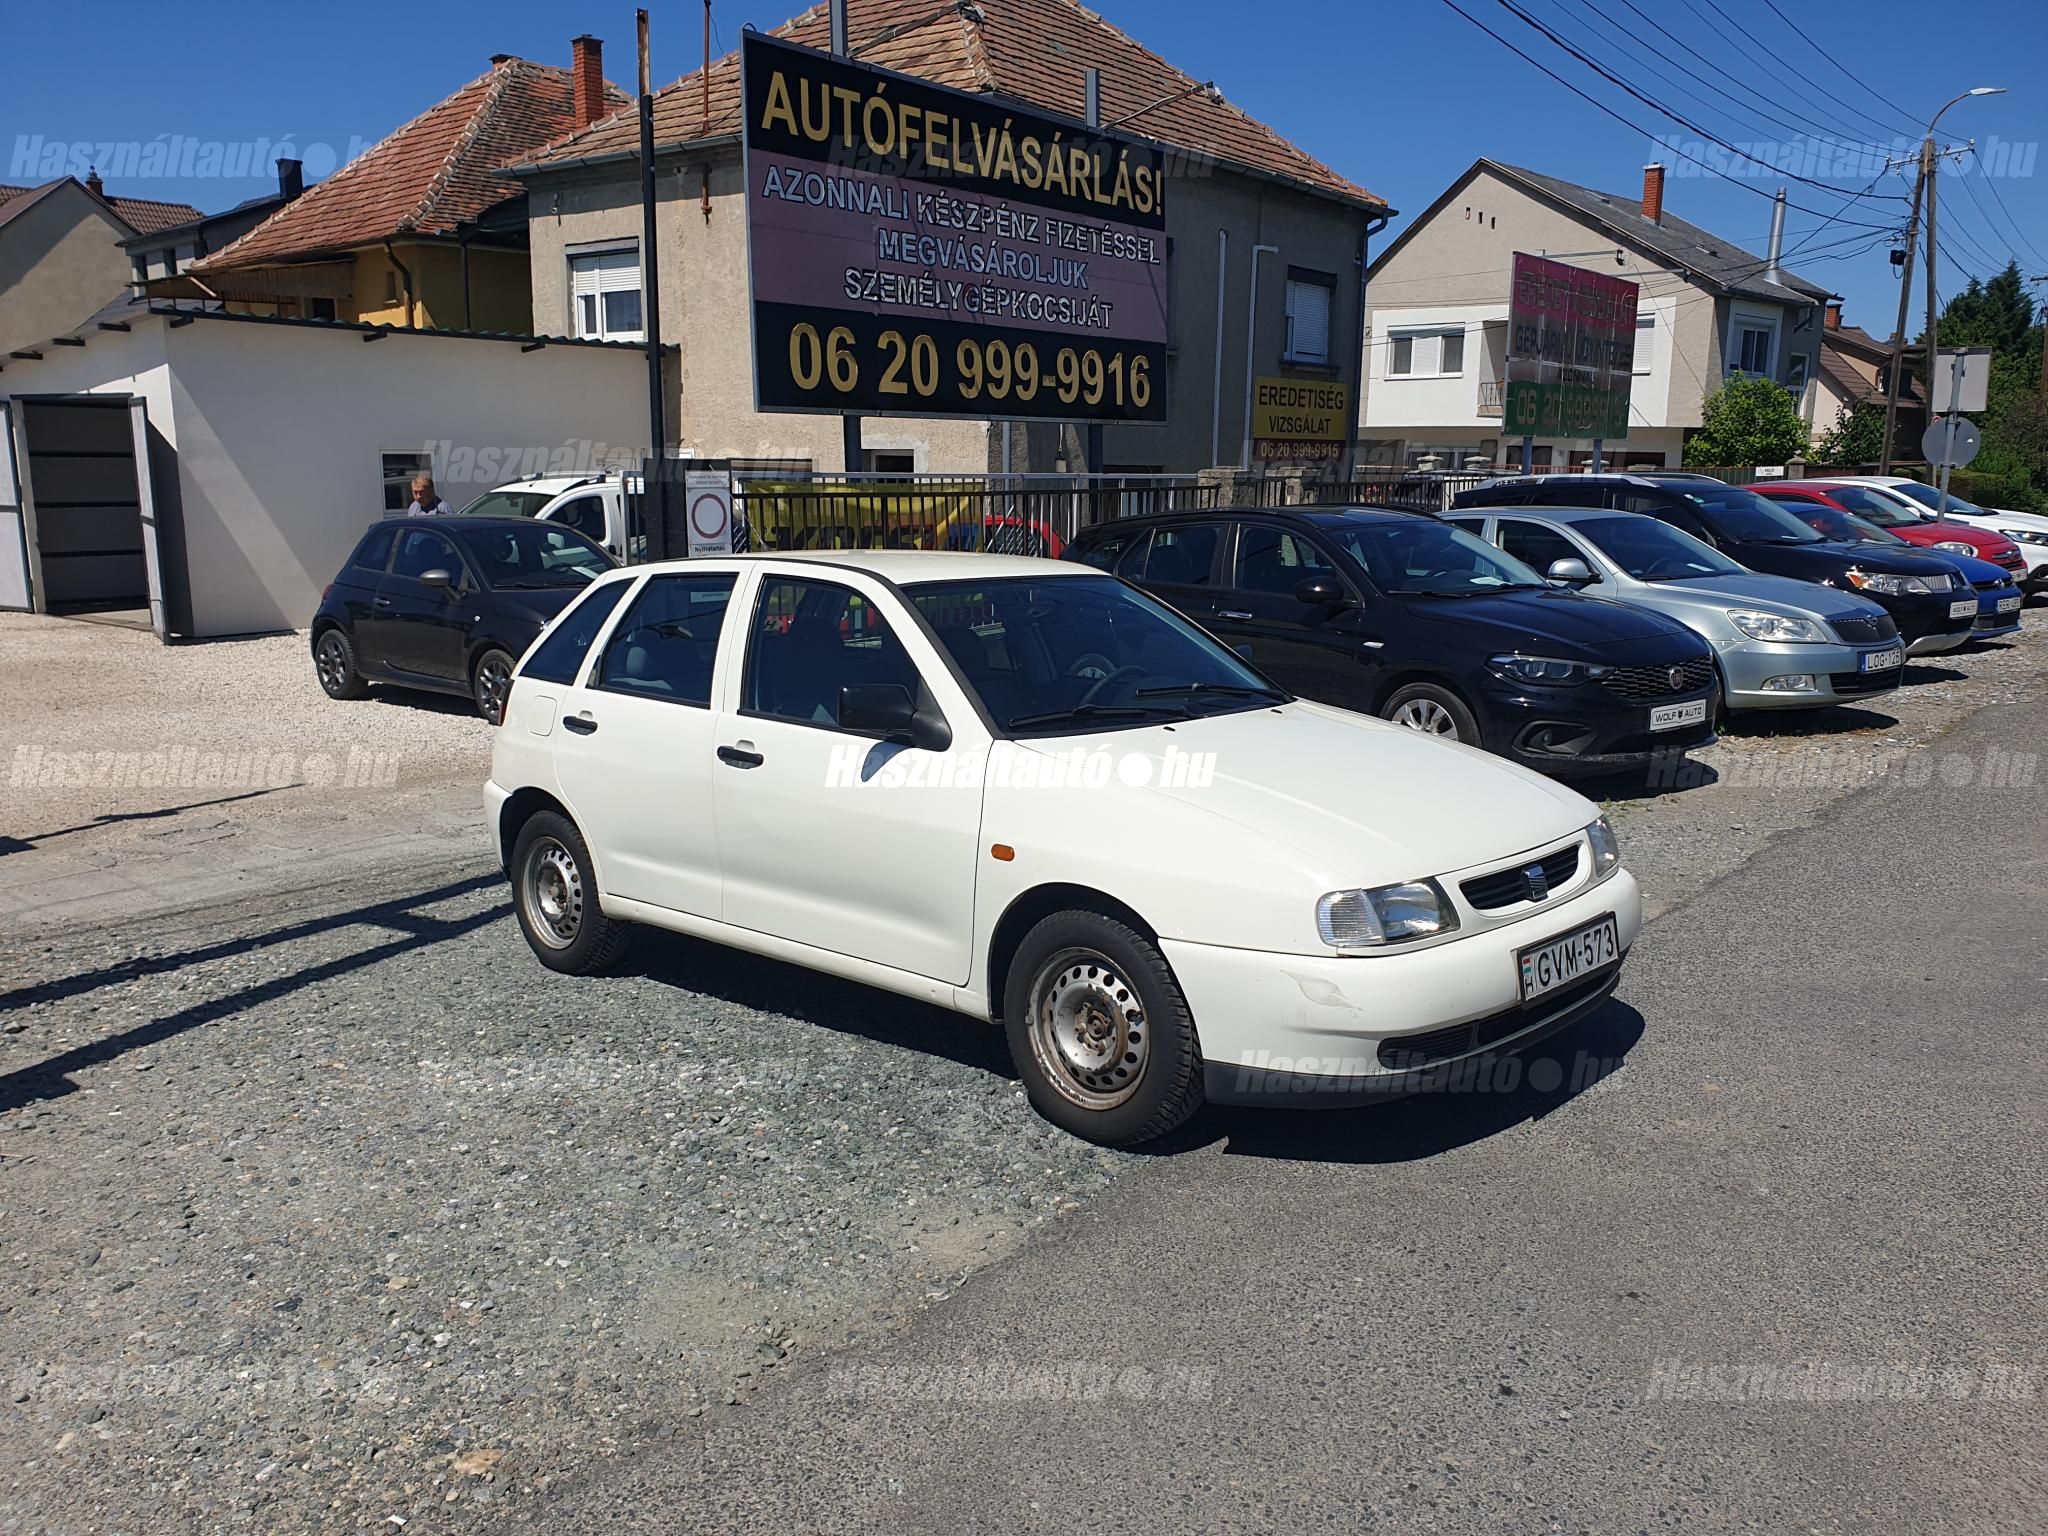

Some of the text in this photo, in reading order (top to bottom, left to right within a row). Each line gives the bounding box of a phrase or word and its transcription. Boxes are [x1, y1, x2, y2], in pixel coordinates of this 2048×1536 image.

[761, 71, 1162, 216] AUTÓFELVÁSÁRLÁS!
[762, 165, 1161, 264] AZONNALI KÉSZPÉNZ FIZETÉSSEL
[878, 228, 1089, 290] MEGVÁSÁROLJUK
[844, 267, 1113, 329] SZEMÉLYGÉPKOCSIJÁT
[789, 322, 1151, 408] 06 20 999-9916
[1259, 385, 1344, 410] EREDETISÉG
[1269, 413, 1331, 434] VIZSGÁLAT
[1261, 442, 1339, 458] 06 20 999-9915
[1867, 651, 1900, 669] LOG-126
[1656, 707, 1702, 722] WOLF AUTO
[1537, 924, 1614, 987] GVM-573
